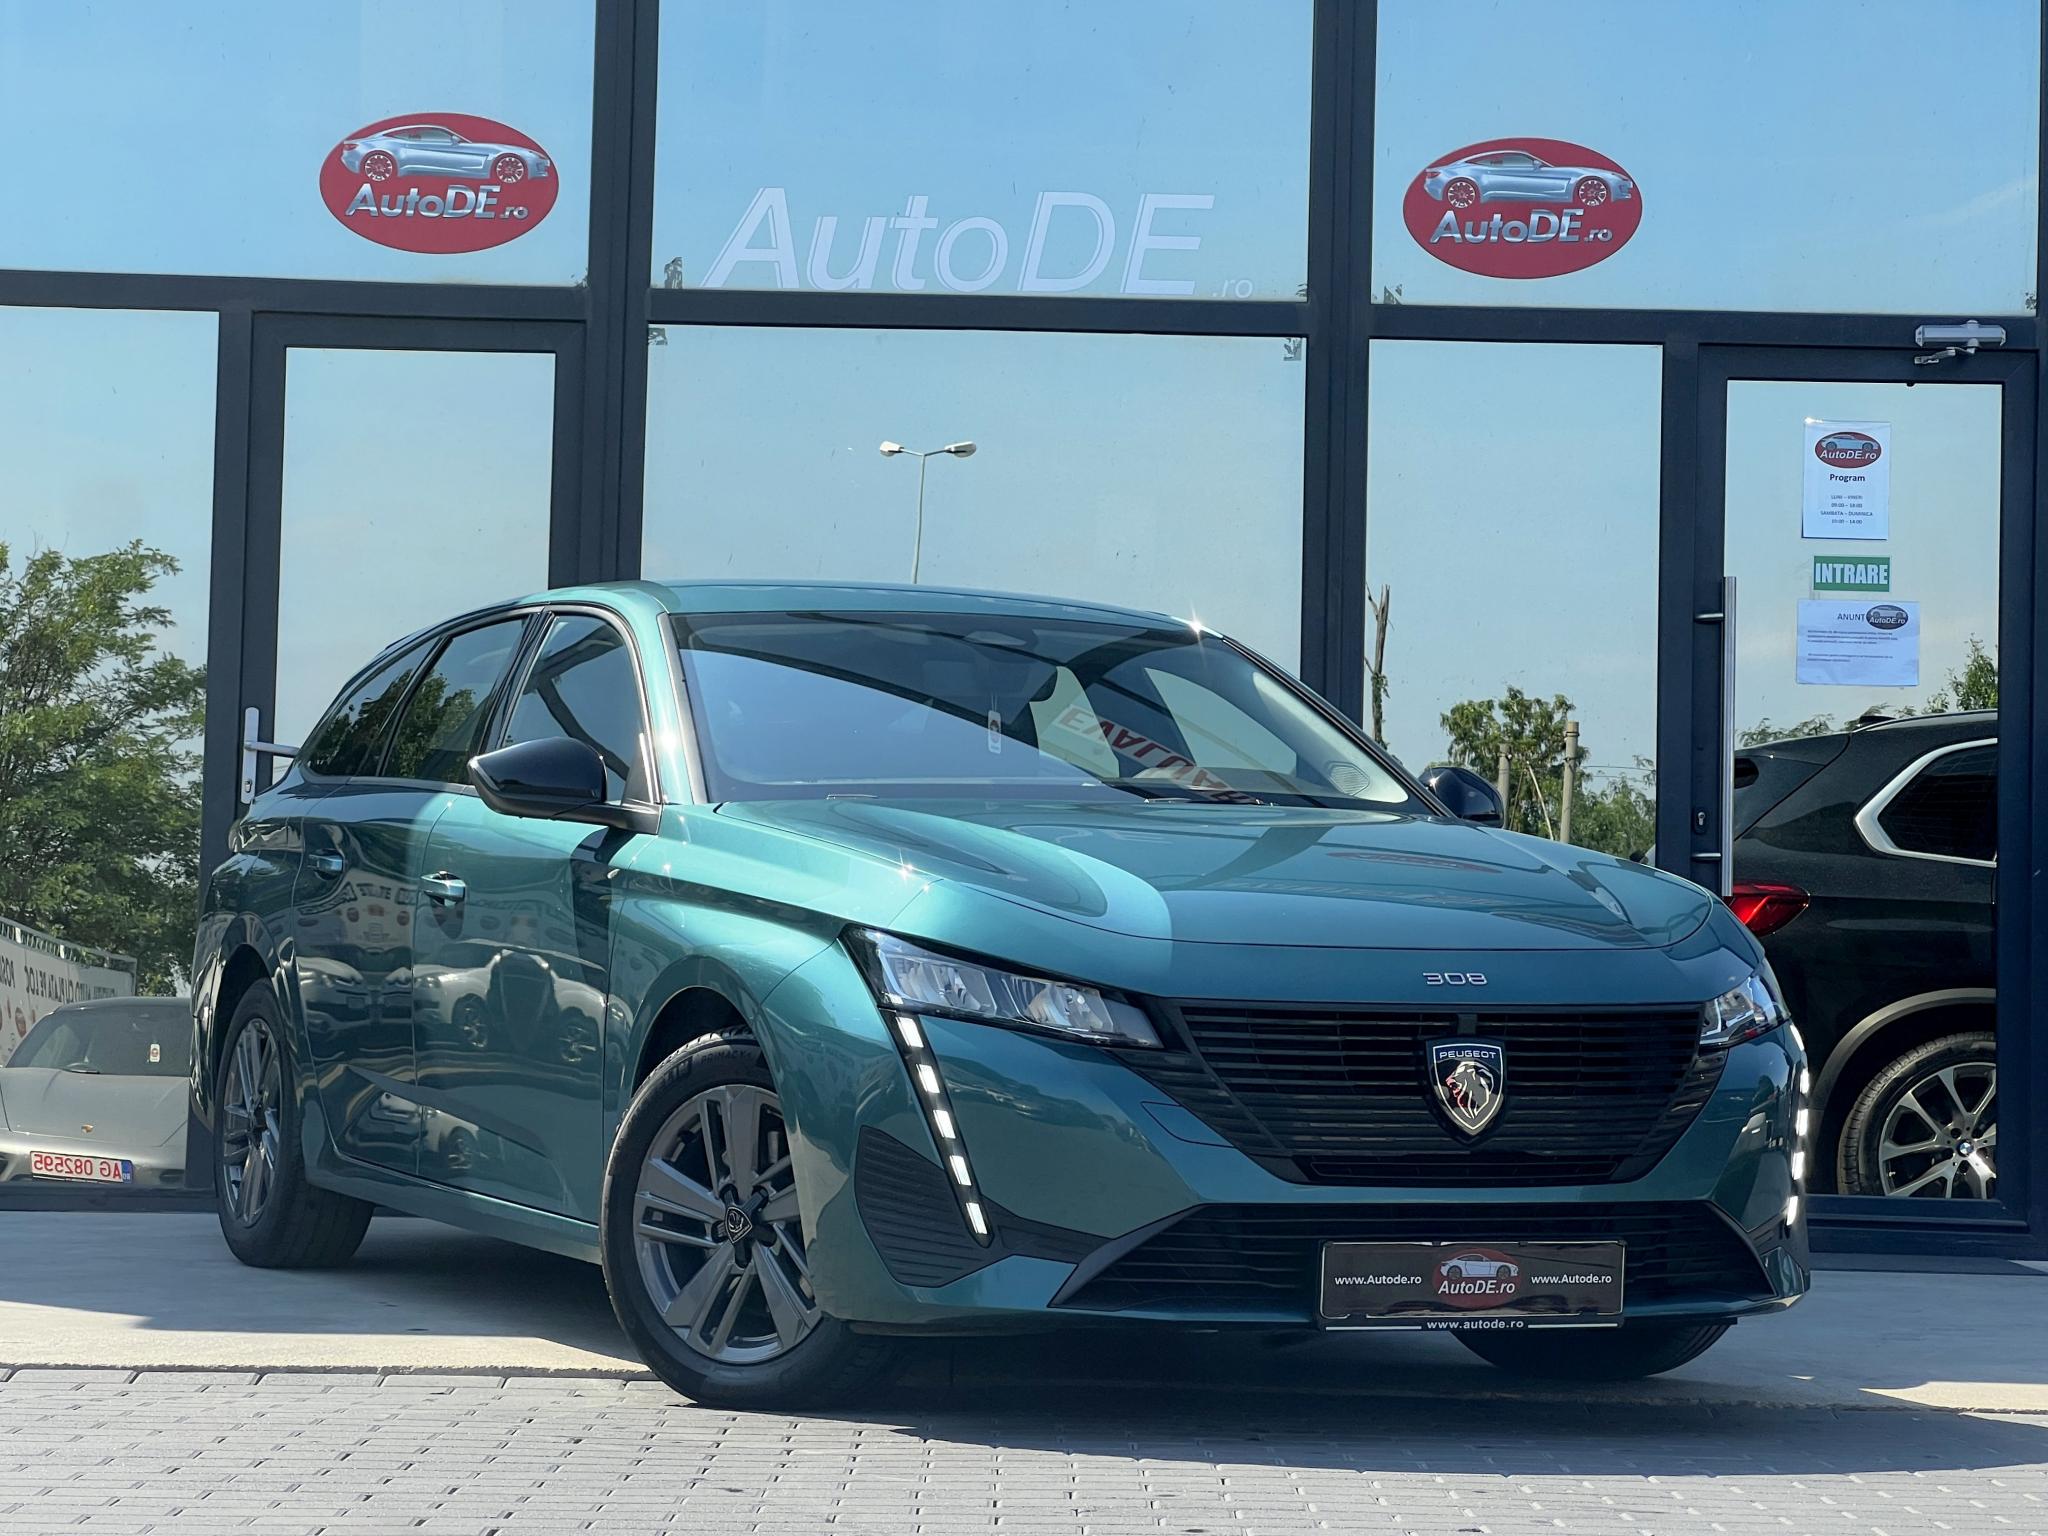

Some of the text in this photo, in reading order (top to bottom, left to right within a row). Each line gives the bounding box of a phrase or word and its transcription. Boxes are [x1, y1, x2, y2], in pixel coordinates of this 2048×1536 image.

[1819, 448, 1877, 461] AutoDE.ro
[1829, 473, 1866, 483] Program
[1815, 562, 1889, 585] INTRARE
[1869, 616, 1906, 625] AutoDE.ro
[1422, 972, 1488, 985] 308
[1439, 1050, 1498, 1059] PEUGEOT
[1334, 1273, 1422, 1286] www.Autode.ro
[1530, 1273, 1613, 1285] www.Autode.ro
[1438, 1279, 1516, 1295] AutoDE.ro
[1426, 1318, 1525, 1330] www.autode.ro
